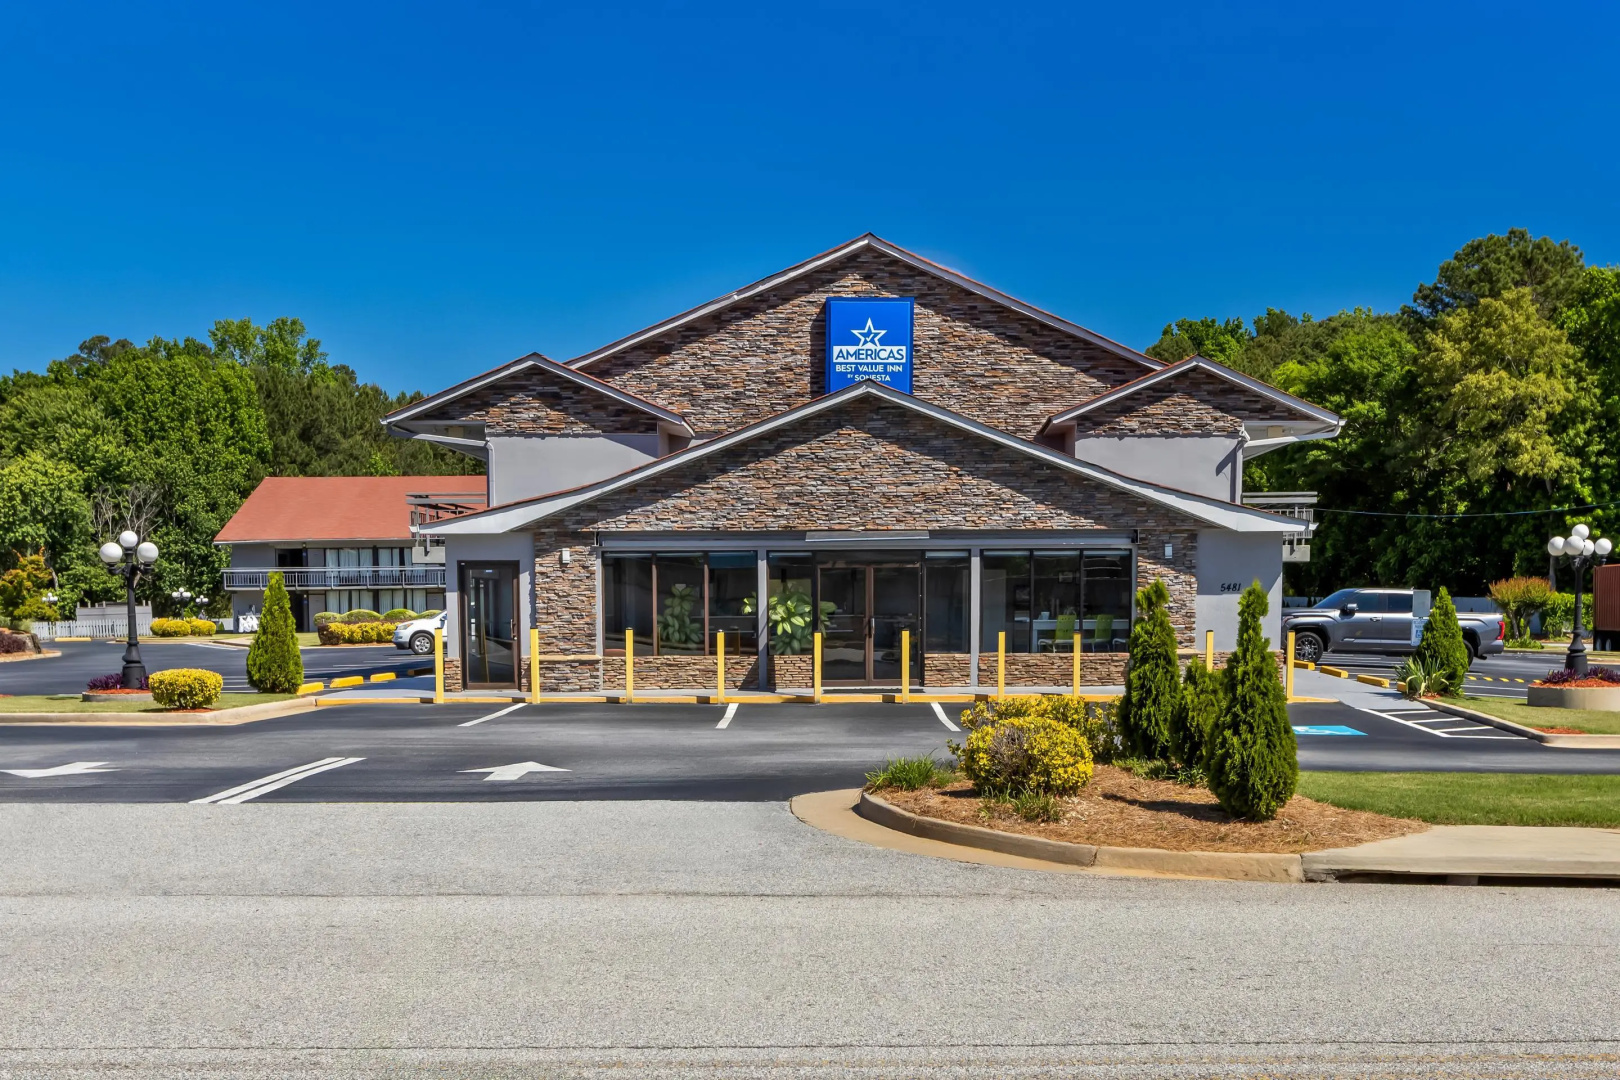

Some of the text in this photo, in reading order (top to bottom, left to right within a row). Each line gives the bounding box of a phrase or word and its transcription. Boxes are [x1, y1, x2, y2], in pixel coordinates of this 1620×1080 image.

[835, 348, 904, 360] AMERICAS
[835, 364, 903, 372] BEST VALUE INN
[1220, 583, 1241, 591] 5481
